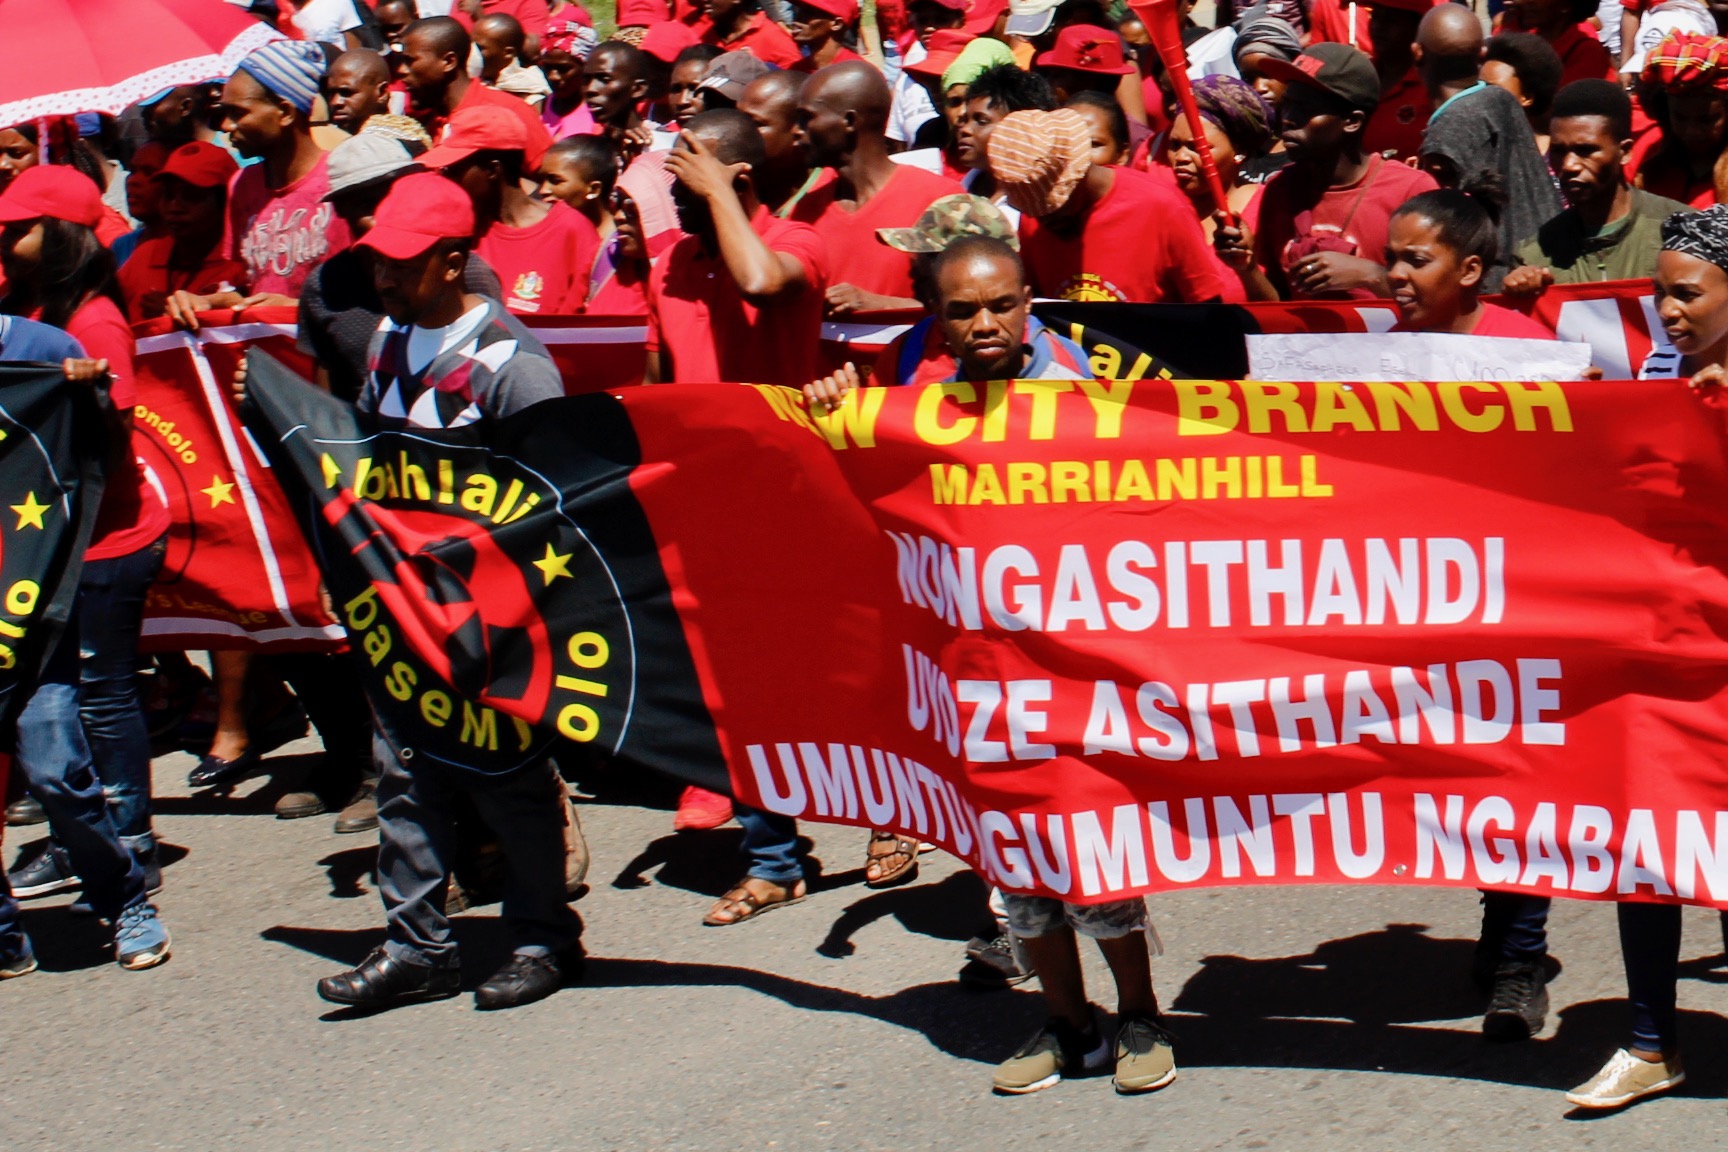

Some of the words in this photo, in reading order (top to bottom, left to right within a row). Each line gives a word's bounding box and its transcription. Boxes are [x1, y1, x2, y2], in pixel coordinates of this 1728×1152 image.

[913, 379, 1134, 446] CITY
[1178, 380, 1575, 437] BRANCH
[931, 454, 1334, 507] MARRIANHILL
[885, 531, 1505, 632] NONGASITHANDI
[902, 643, 1057, 763] UYOZE
[1083, 658, 1566, 762] ASITHANDE
[745, 742, 973, 856] UMUNTU
